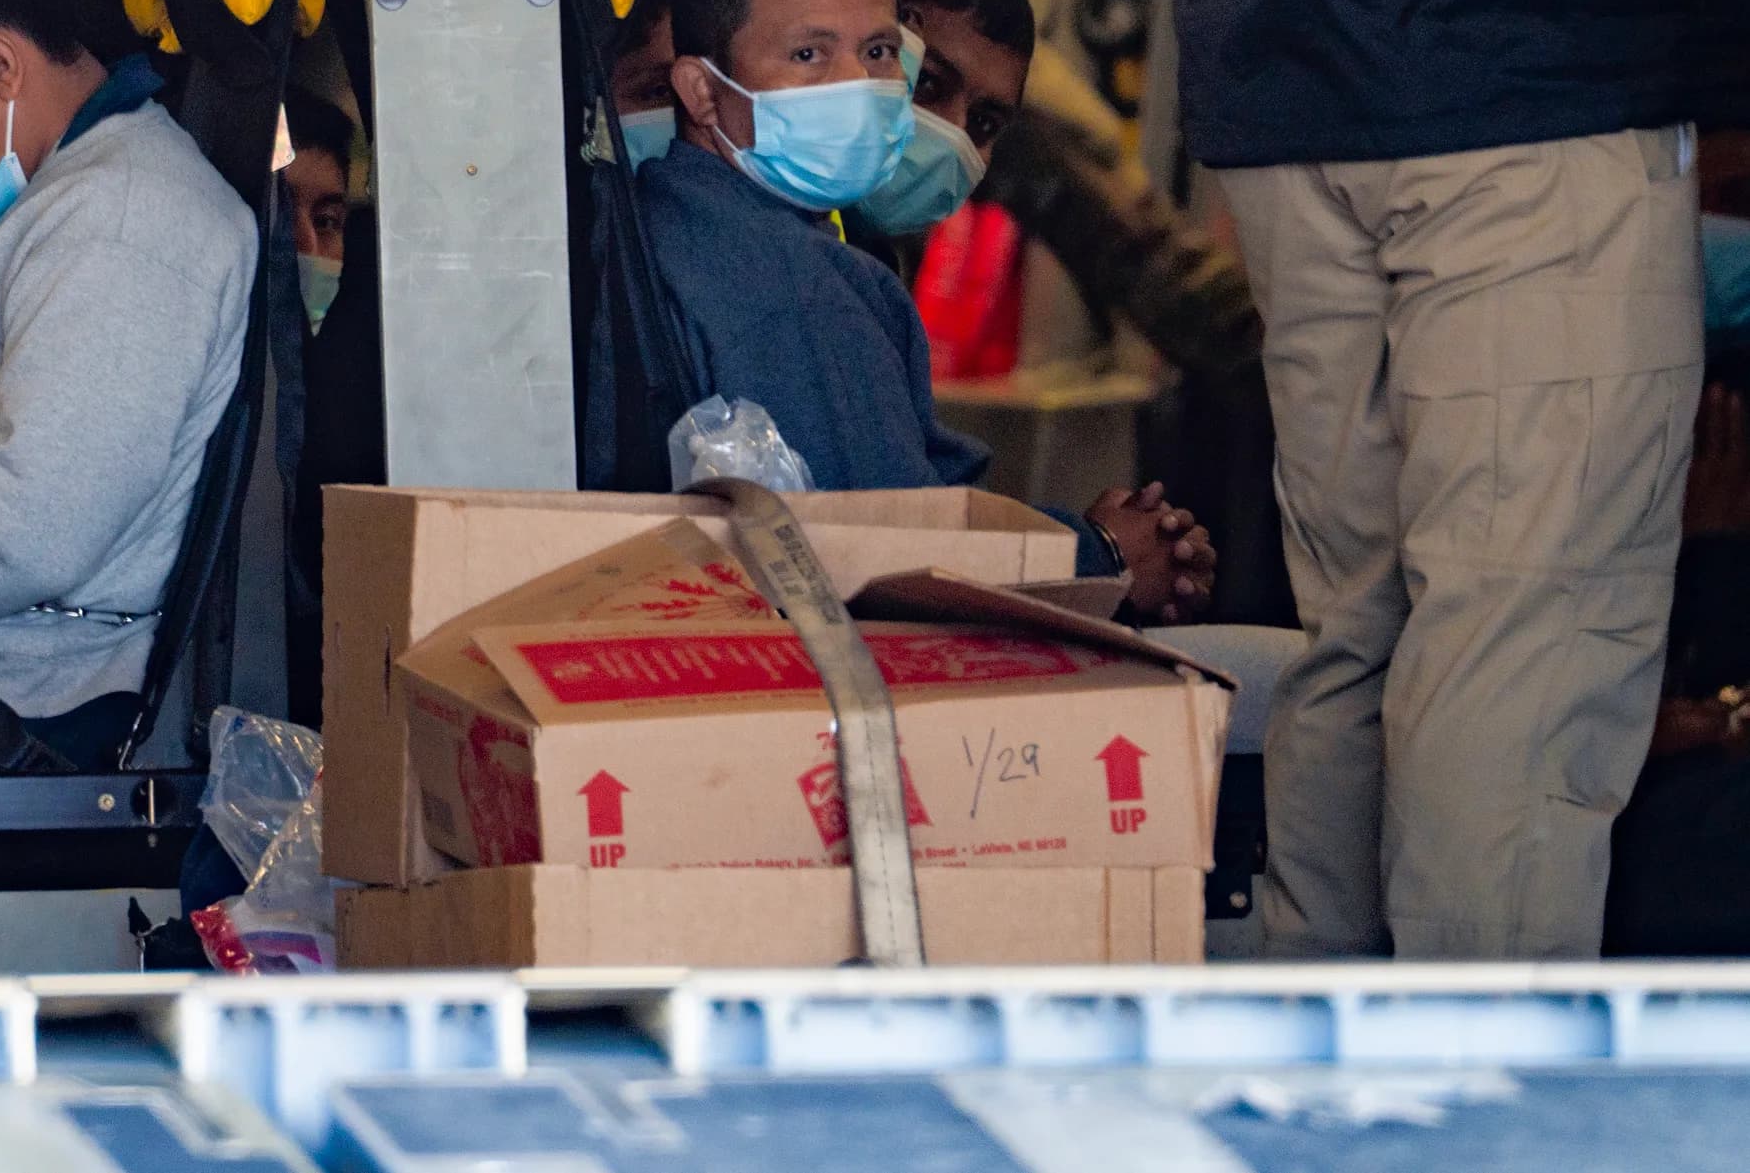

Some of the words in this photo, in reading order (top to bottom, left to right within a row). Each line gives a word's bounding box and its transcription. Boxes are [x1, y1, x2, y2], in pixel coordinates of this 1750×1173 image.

[961, 727, 1041, 819] 1/29
[1109, 808, 1147, 834] UP
[590, 843, 626, 868] UP
